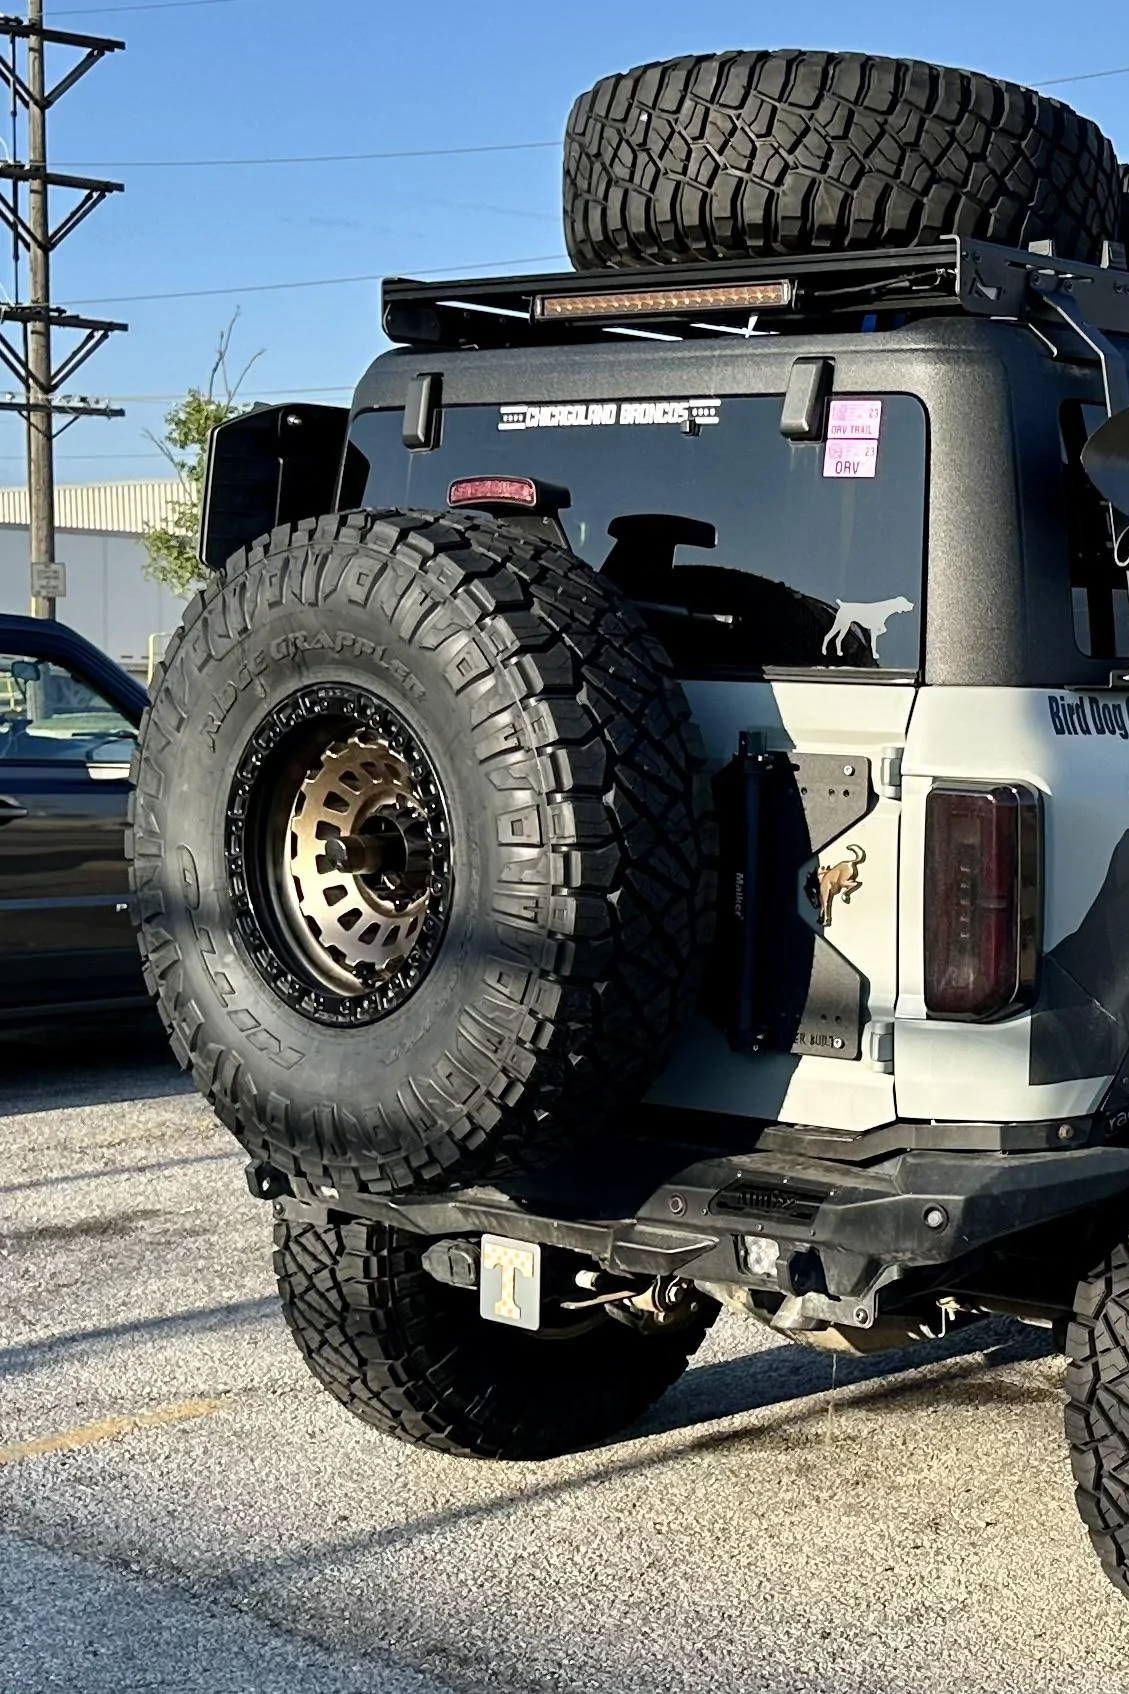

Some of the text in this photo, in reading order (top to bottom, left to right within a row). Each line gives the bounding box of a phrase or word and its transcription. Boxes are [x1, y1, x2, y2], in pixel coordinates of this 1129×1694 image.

[525, 402, 689, 428] CHICAGOLAND BRONCOS
[868, 408, 879, 419] 23
[831, 425, 872, 435] ORV TRAIL
[865, 447, 875, 457] 23
[835, 460, 860, 475] ORV
[1048, 695, 1092, 736] Bird
[1088, 697, 1129, 740] Dog
